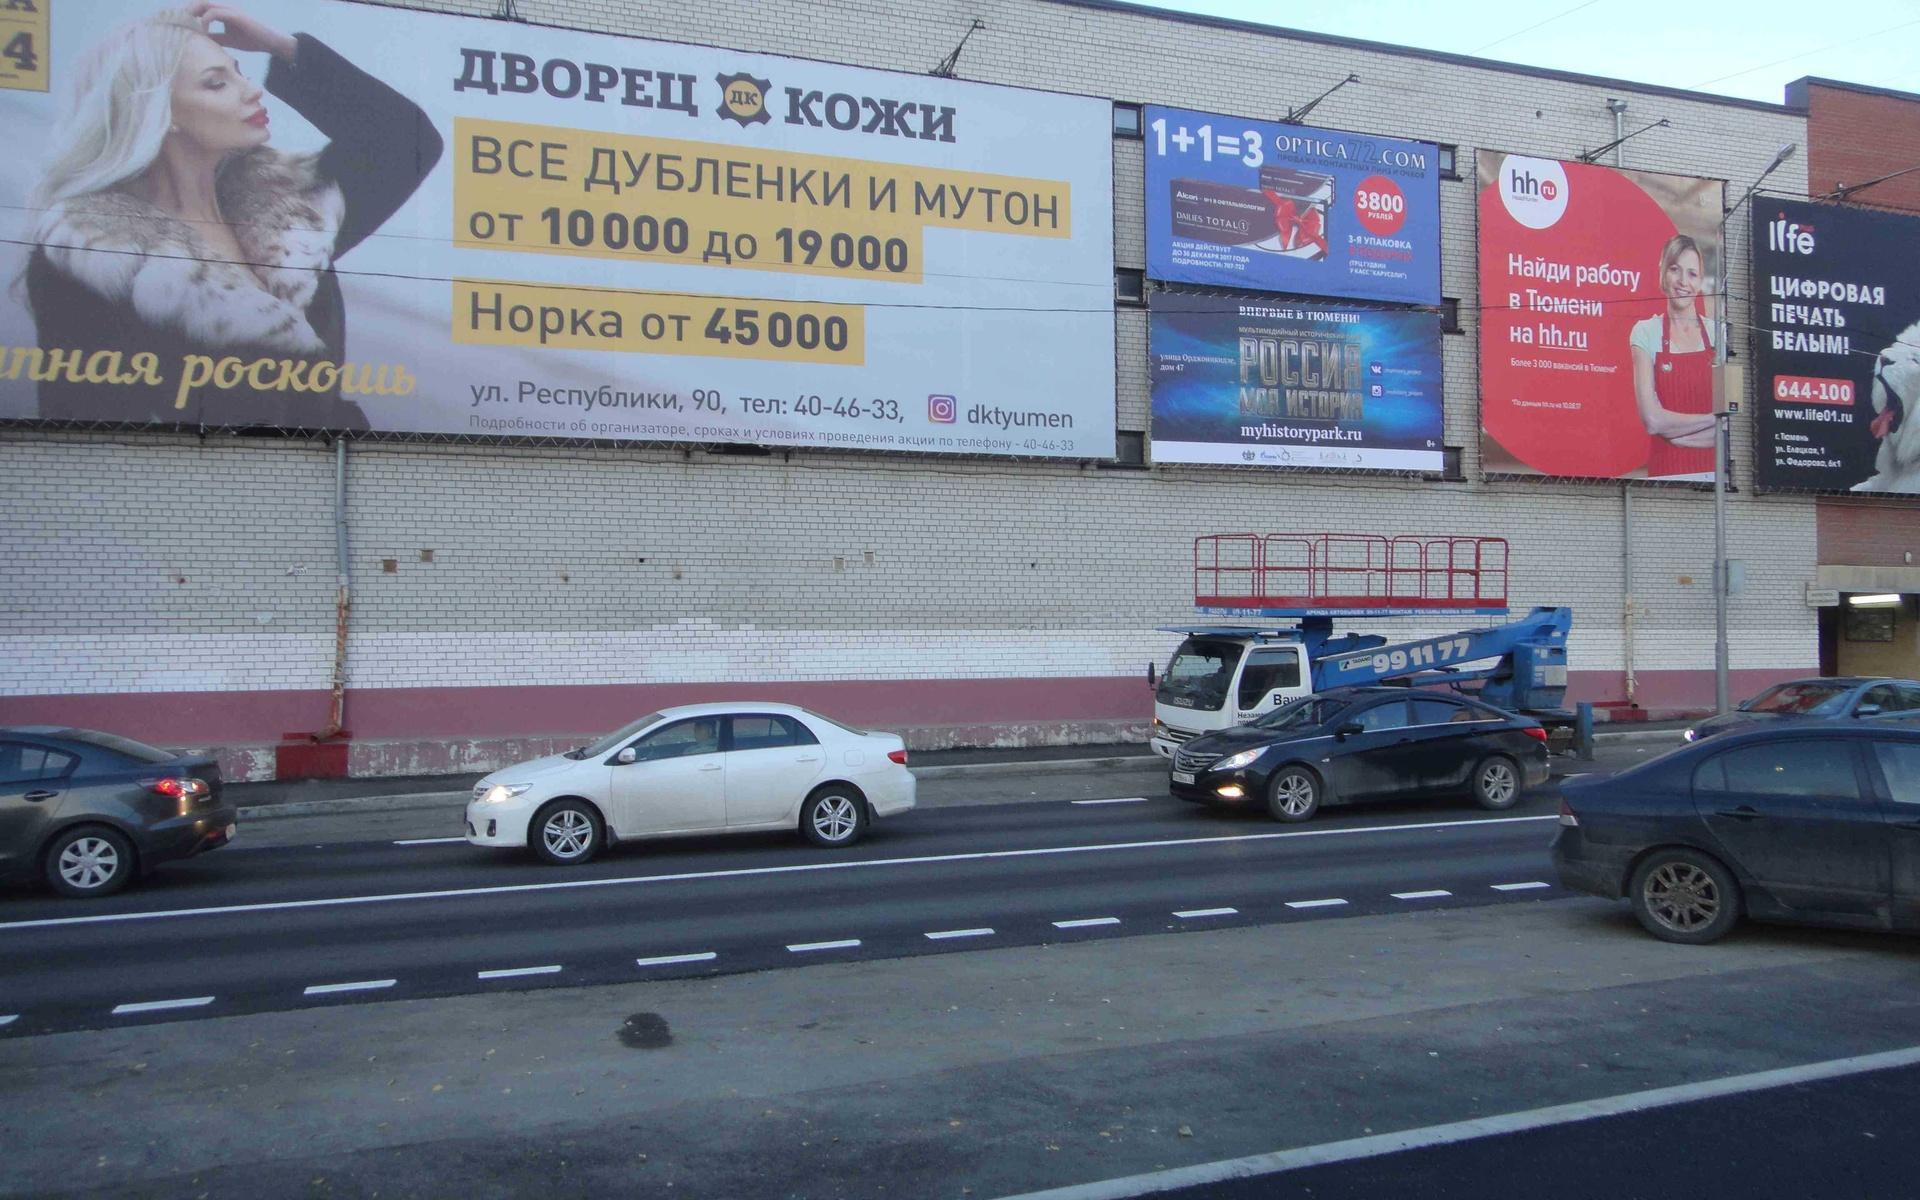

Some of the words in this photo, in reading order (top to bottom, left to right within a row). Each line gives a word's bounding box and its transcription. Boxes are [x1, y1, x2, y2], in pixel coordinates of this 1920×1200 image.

[453, 47, 699, 118] ДВОРЕЦ
[729, 89, 758, 106] ДК
[784, 86, 957, 143] КОЖИ
[1151, 117, 1265, 169] 1+1=3
[1275, 134, 1427, 170] OPTICA72.COM
[471, 134, 568, 182] ВСЕ
[583, 146, 851, 209] ДУБЛЕНКИ
[869, 175, 896, 213] И
[914, 180, 1058, 229] МУТОН
[1511, 168, 1539, 196] hh
[1357, 190, 1404, 214] 3800
[468, 210, 524, 241] от
[702, 229, 758, 265] до
[1363, 235, 1413, 250] УПАКОВКА
[1508, 252, 1571, 284] Найди
[1575, 263, 1641, 293] работу
[1509, 291, 1521, 310] в
[1525, 288, 1603, 317] Тюмени
[1770, 275, 1885, 306] ЦИФРОВАЯ
[469, 291, 623, 345] Норка
[640, 312, 691, 342] от
[1239, 305, 1294, 320] ВПЕРВЫЕ
[1296, 309, 1304, 321] В
[1305, 311, 1361, 325] ТЮМЕНИ!
[1771, 302, 1846, 328] ПЕЧАТЬ
[1509, 325, 1534, 345] на
[1538, 323, 1588, 350] hh.ru
[1772, 330, 1850, 355] БЕЛЫМ!
[1239, 336, 1361, 390] РОССИЯ
[174, 353, 417, 410] роскошь
[1777, 380, 1851, 402] 644-100
[470, 384, 509, 407] ул.
[518, 380, 684, 413] Республики,
[691, 389, 727, 415] 90,
[739, 396, 788, 416] тел:
[793, 395, 905, 424] 40-46-33,
[967, 404, 1074, 430] dktyumen
[1286, 388, 1364, 420] ИСТОРИЯ
[1774, 408, 1853, 424] www.life01.ru
[469, 415, 566, 431] Подробности
[570, 419, 587, 432] об
[591, 421, 690, 437] организаторе,
[694, 426, 740, 439] сроках
[743, 429, 752, 437] и
[755, 429, 816, 443] условиях
[818, 430, 895, 446] проведения
[898, 434, 935, 448] акции
[939, 437, 954, 447] по
[956, 437, 1012, 451] телефону
[1023, 439, 1075, 452] 40-46-33
[1240, 423, 1363, 442] myhistorypark.ru
